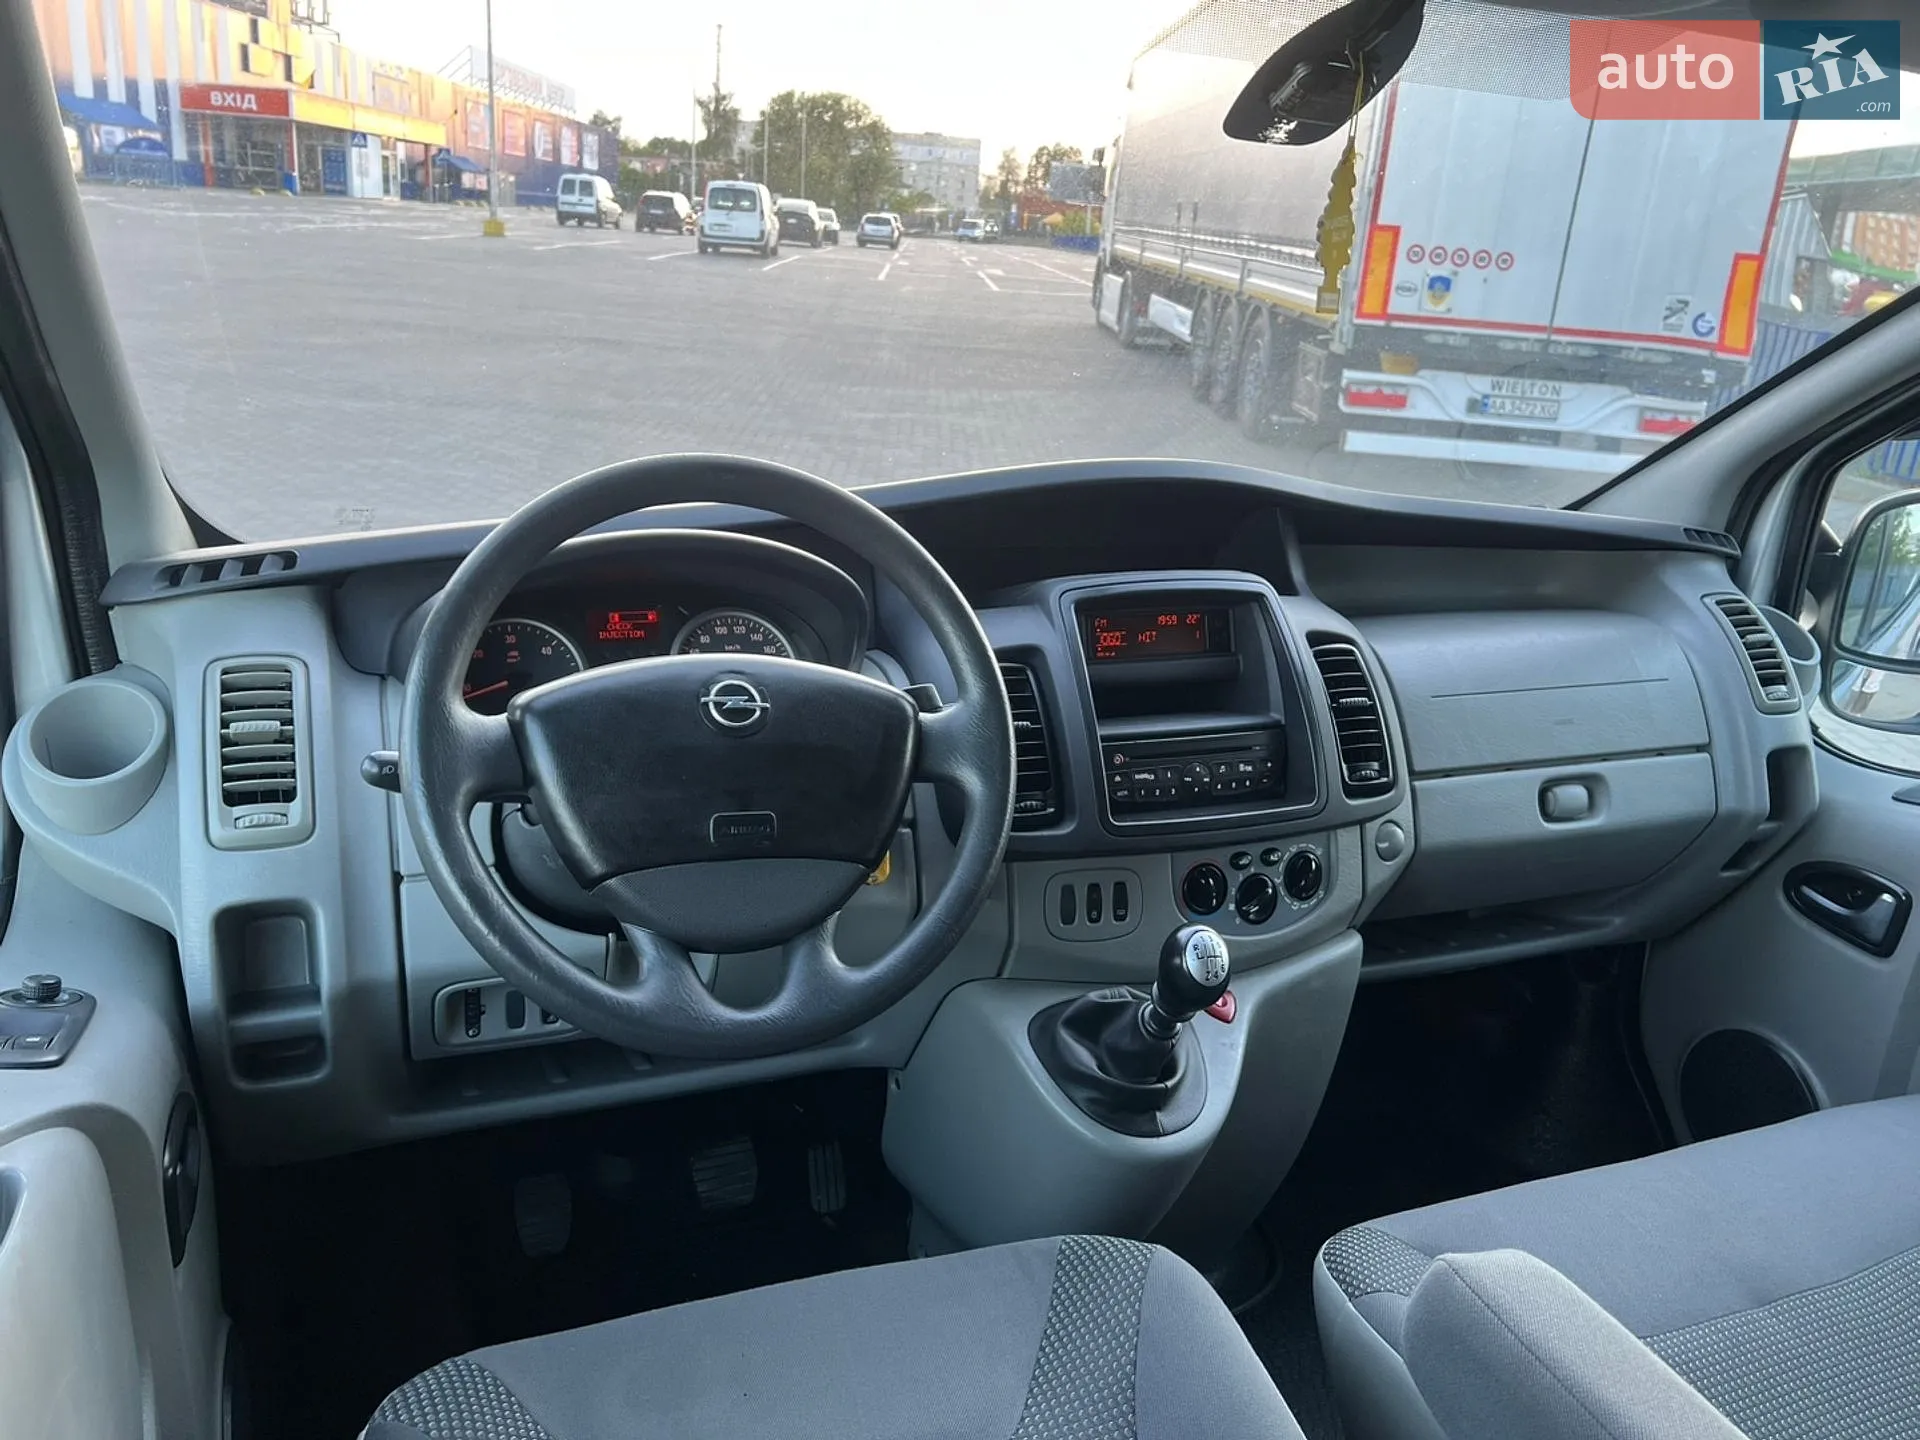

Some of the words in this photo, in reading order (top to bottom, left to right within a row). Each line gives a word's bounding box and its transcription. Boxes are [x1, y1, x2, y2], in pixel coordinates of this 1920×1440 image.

[209, 91, 257, 111] ВХІД
[1490, 378, 1561, 398] WIELTON
[606, 622, 633, 631] CHECK
[714, 626, 728, 636] 100
[733, 625, 746, 635] 120
[505, 635, 517, 644] 30
[599, 630, 646, 640] INJECTION
[700, 635, 711, 644] 80
[750, 633, 763, 642] 140
[541, 646, 553, 656] 40
[763, 645, 776, 655] 160
